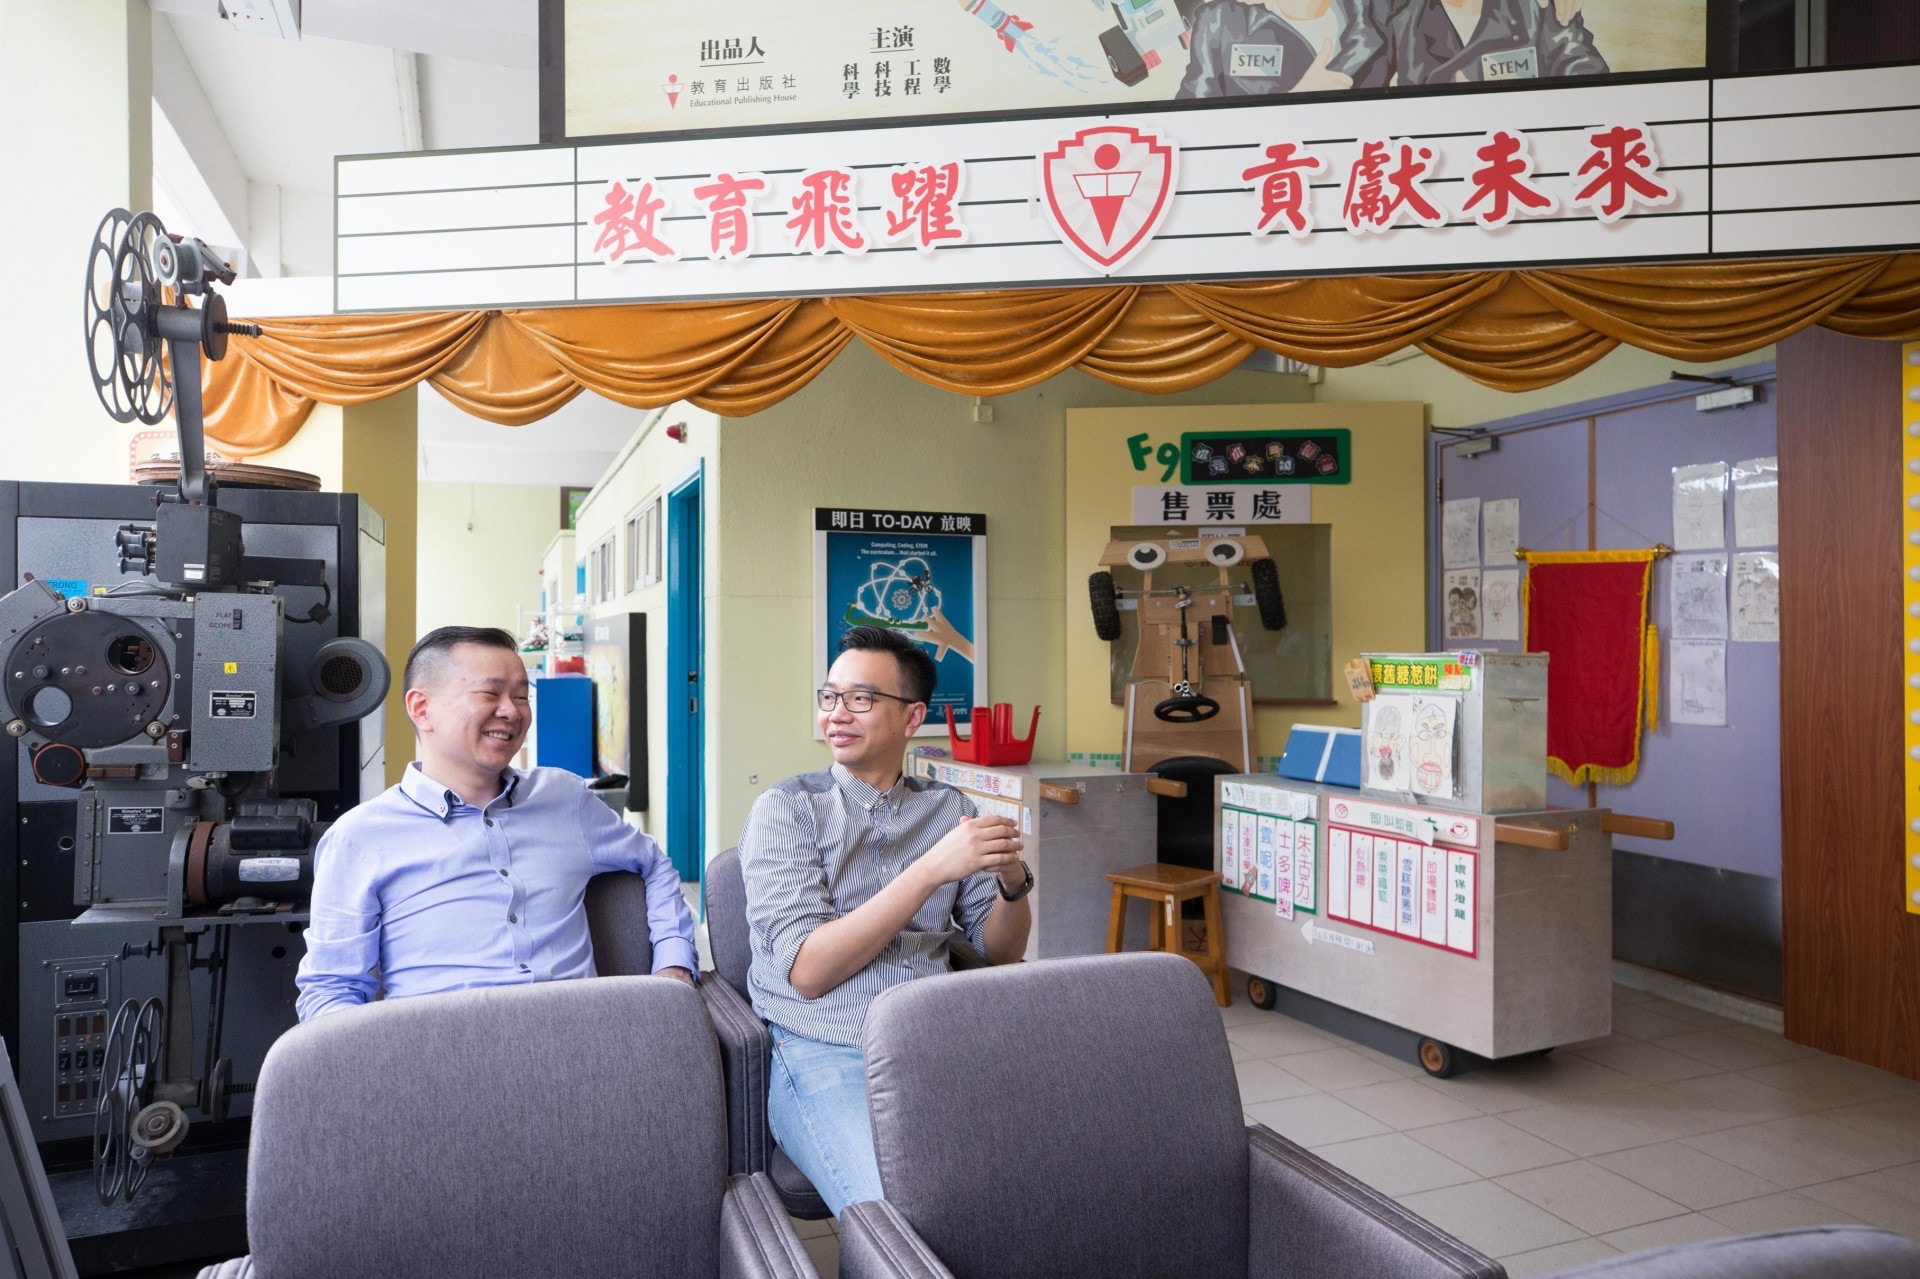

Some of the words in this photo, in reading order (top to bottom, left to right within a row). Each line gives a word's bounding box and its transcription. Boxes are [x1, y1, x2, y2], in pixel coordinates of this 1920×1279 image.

[700, 36, 766, 61] 出品人
[870, 25, 914, 49] 主演
[1238, 54, 1276, 68] STEM
[1490, 58, 1530, 77] STEM
[690, 73, 797, 95] 教育出版社
[842, 63, 860, 99] 科學
[874, 61, 891, 97] 科技
[904, 59, 921, 96] 工程
[933, 57, 951, 94] 數學
[690, 97, 732, 107] Educational
[734, 96, 772, 106] Publishing
[773, 93, 797, 102] House
[593, 161, 962, 262] 教育飛躍
[1242, 126, 1668, 231] 貢獻未來
[1127, 432, 1181, 483] F9
[1161, 490, 1282, 521] 售票處
[831, 511, 864, 529] 即日
[872, 513, 933, 530] TO-DAY
[940, 515, 972, 532] 放映
[871, 541, 897, 549] Computing,
[47, 581, 77, 589] TRONG
[1278, 832, 1292, 917] 士多啤梨
[1296, 834, 1311, 901] 朱古力
